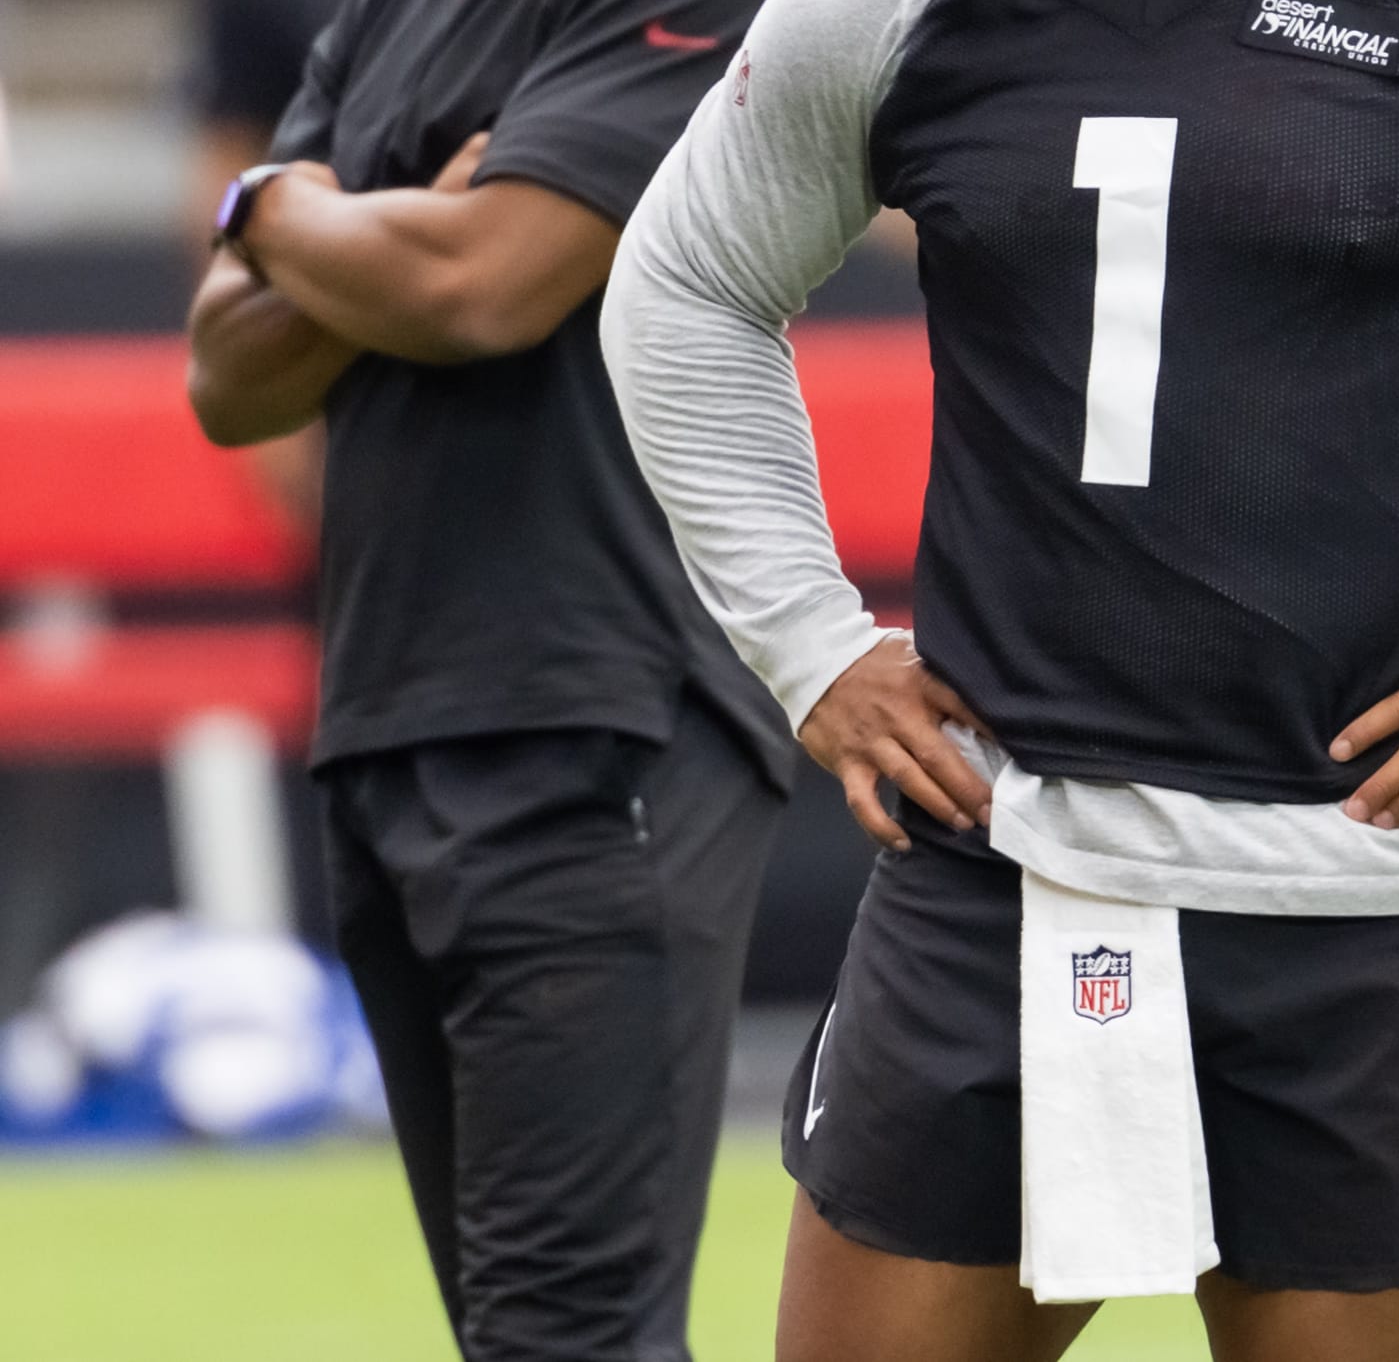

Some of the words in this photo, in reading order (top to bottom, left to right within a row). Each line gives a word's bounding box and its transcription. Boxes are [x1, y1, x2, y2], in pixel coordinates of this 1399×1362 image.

[1347, 52, 1389, 67] UNION
[1073, 116, 1178, 487] 1
[1079, 979, 1126, 1016] NFL
